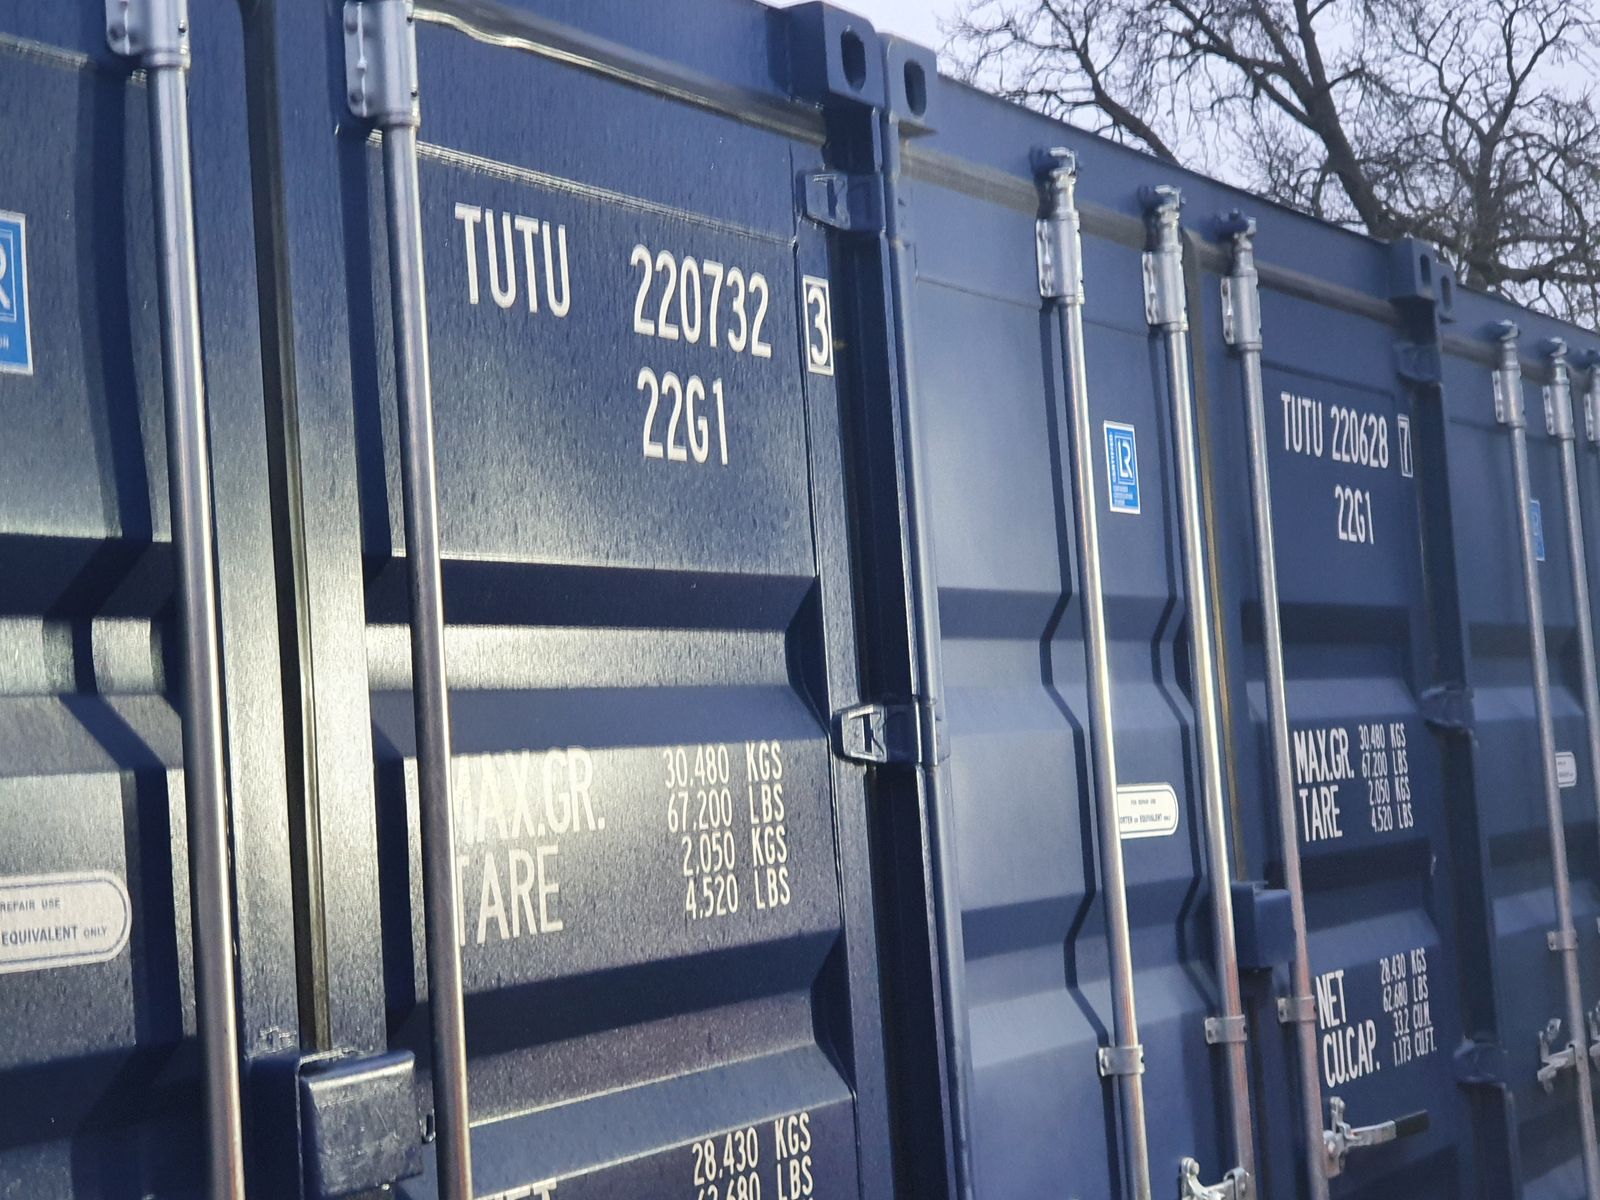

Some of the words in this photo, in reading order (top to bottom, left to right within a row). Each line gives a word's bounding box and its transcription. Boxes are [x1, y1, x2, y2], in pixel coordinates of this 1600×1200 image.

[455, 202, 571, 318] TUTU
[630, 244, 772, 358] 220732
[806, 284, 831, 370] 3
[637, 367, 728, 465] 22G1
[1280, 391, 1324, 458] TUTU
[1330, 404, 1389, 469] 220628
[1398, 418, 1411, 474] 7
[1335, 484, 1374, 544] 22G1
[745, 740, 783, 783] KGS
[1293, 727, 1355, 785] MAX.GR.
[1389, 722, 1406, 749] KGS
[1392, 749, 1409, 776] LBS
[748, 783, 785, 825] LBS
[1299, 784, 1343, 843] TARE
[1394, 776, 1411, 803] KGS
[1397, 802, 1414, 829] LBS
[751, 825, 788, 868] KGS
[754, 866, 791, 910] LBS
[2, 925, 78, 946] EQUIVALENT
[83, 926, 108, 939] ONLY
[1315, 969, 1347, 1030] NET
[1410, 947, 1427, 975] KGS
[1413, 974, 1429, 1002] LBS
[1322, 1018, 1381, 1089] CU.CAP.
[774, 1111, 812, 1161] KGS
[776, 1154, 814, 1200] LBS
